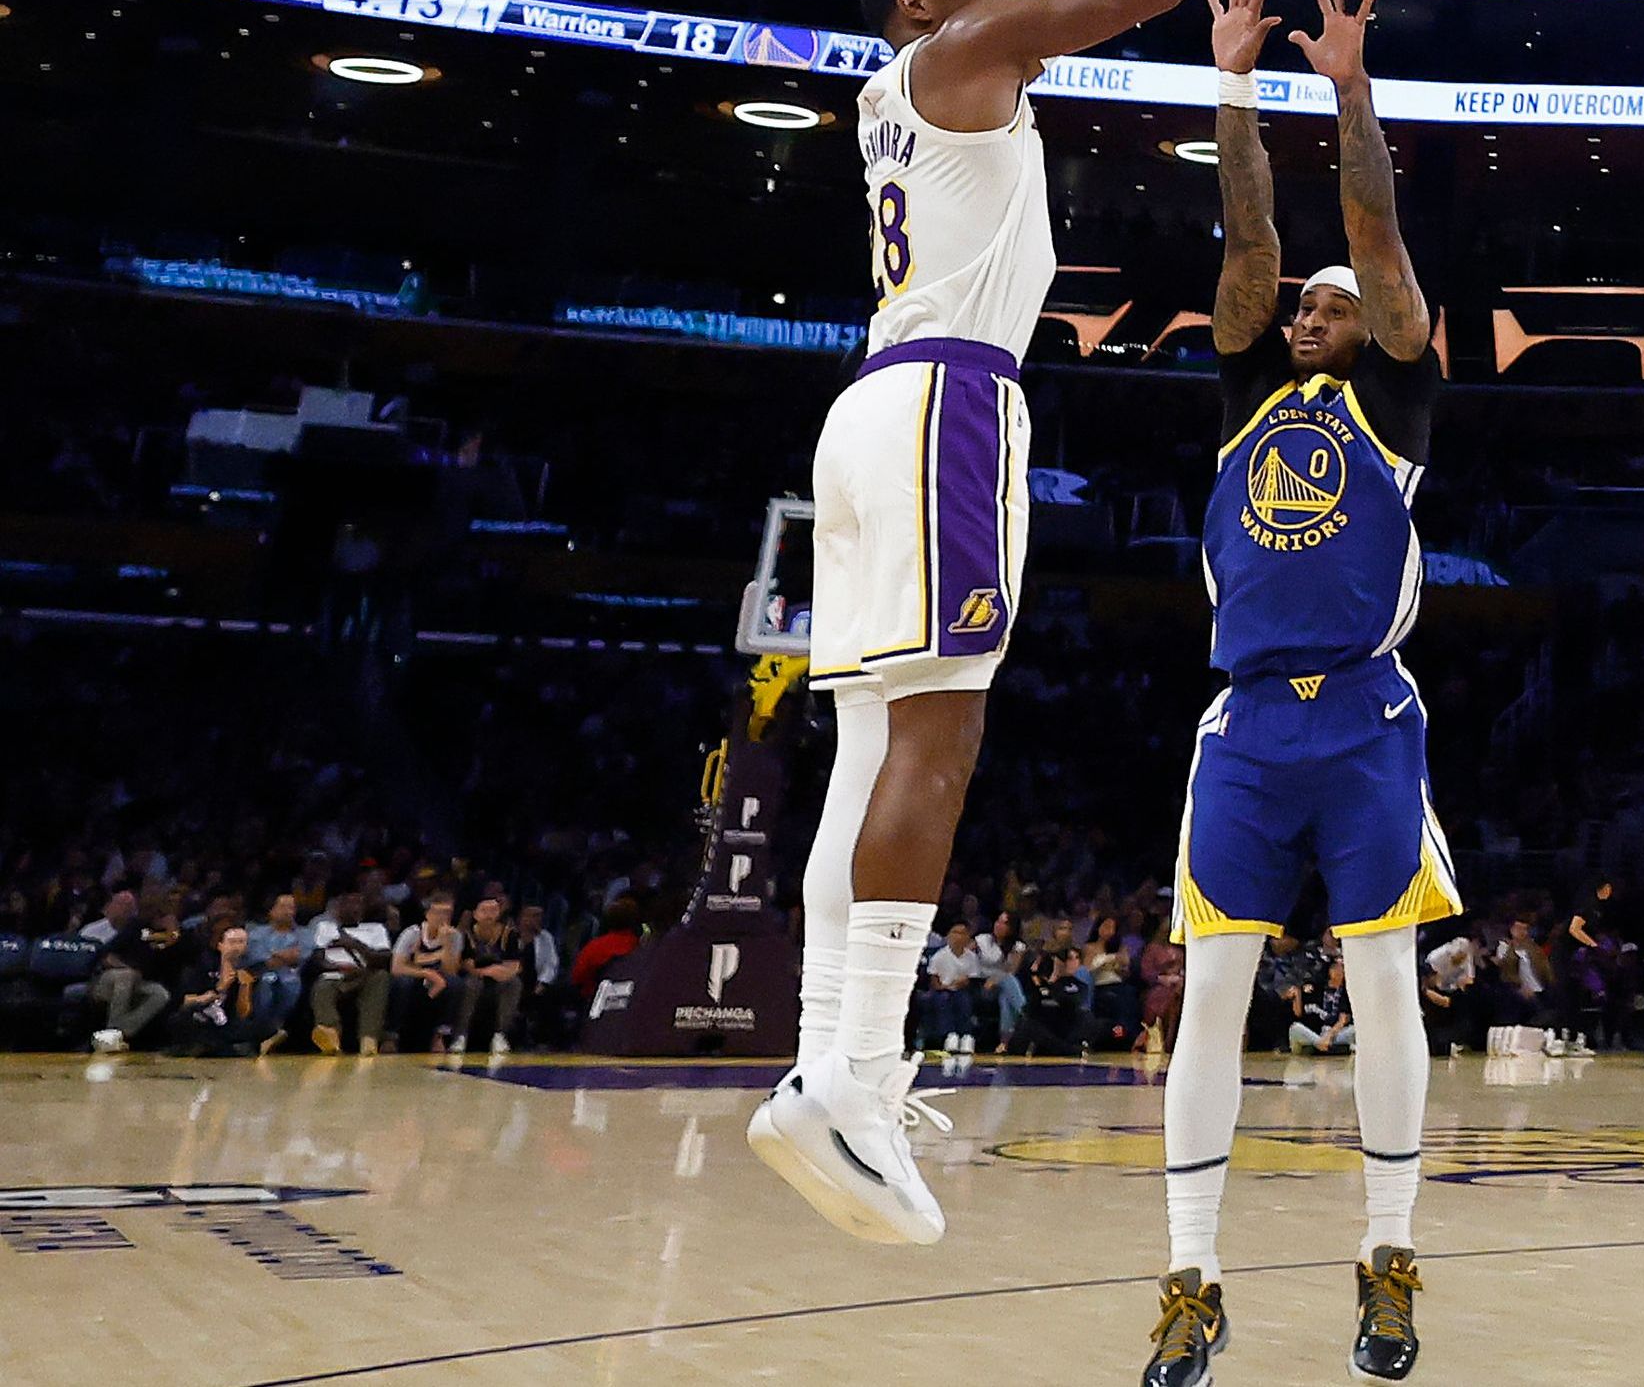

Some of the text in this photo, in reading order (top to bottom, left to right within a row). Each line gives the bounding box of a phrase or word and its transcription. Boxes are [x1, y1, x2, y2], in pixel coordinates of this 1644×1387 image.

[521, 3, 627, 39] Warriors
[671, 21, 717, 54] 18
[838, 50, 855, 70] 3
[1042, 64, 1134, 92] ALLENGE
[1258, 81, 1289, 100] CLA
[1454, 90, 1504, 114] KEEP
[1512, 93, 1539, 115] ON
[1315, 411, 1355, 444] STATE
[1309, 448, 1329, 479] 0
[1240, 506, 1349, 552] WARRIORS
